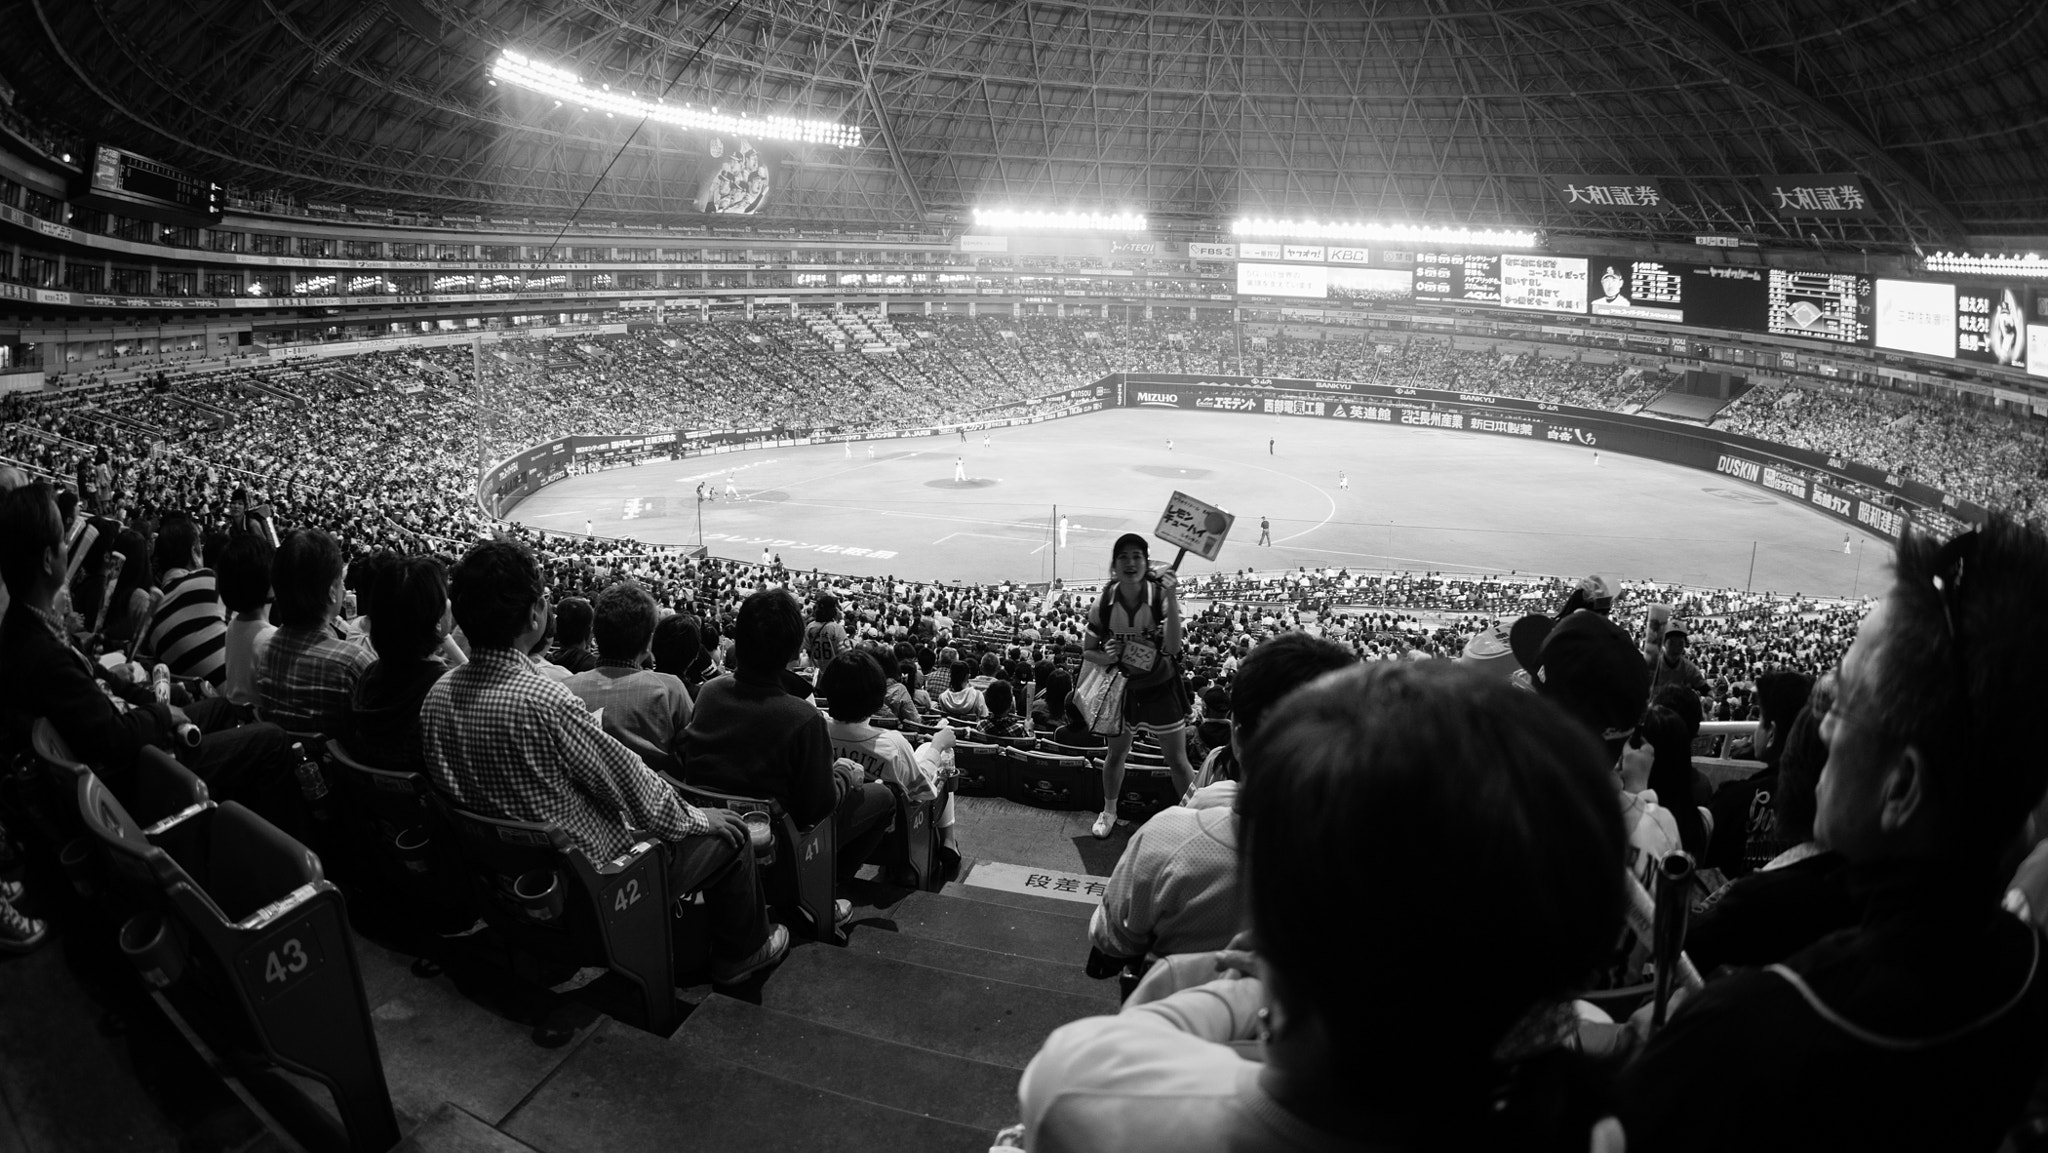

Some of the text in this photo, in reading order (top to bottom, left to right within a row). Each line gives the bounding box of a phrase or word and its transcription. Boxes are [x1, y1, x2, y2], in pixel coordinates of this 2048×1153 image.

[1563, 184, 1660, 206] 大和証券
[1773, 186, 1864, 211] 大和証券
[1200, 247, 1223, 256] FBS
[1288, 248, 1322, 258] ヤフオク!
[1331, 249, 1364, 261] KBC
[1416, 253, 1424, 262] B
[1416, 267, 1424, 277] S
[1463, 291, 1501, 300] AQUA
[1672, 337, 1686, 346] you
[1674, 344, 1686, 352] me
[1780, 351, 1795, 361] you
[1783, 359, 1795, 367] me
[1315, 381, 1352, 390] SANKYU
[1264, 399, 1325, 416] 西部電気工業
[1460, 394, 1495, 404] SANKYU
[1350, 404, 1391, 421] 英進館
[1420, 411, 1464, 429] 長州産業
[1470, 417, 1533, 436] 新日本製薬
[1716, 455, 1760, 482] DUSKIN
[1167, 504, 1194, 521] レモン
[1163, 513, 1208, 538] チューハイ
[913, 813, 925, 830] 40
[804, 838, 820, 862] 41
[614, 878, 642, 912] 42
[264, 937, 309, 984] 43
